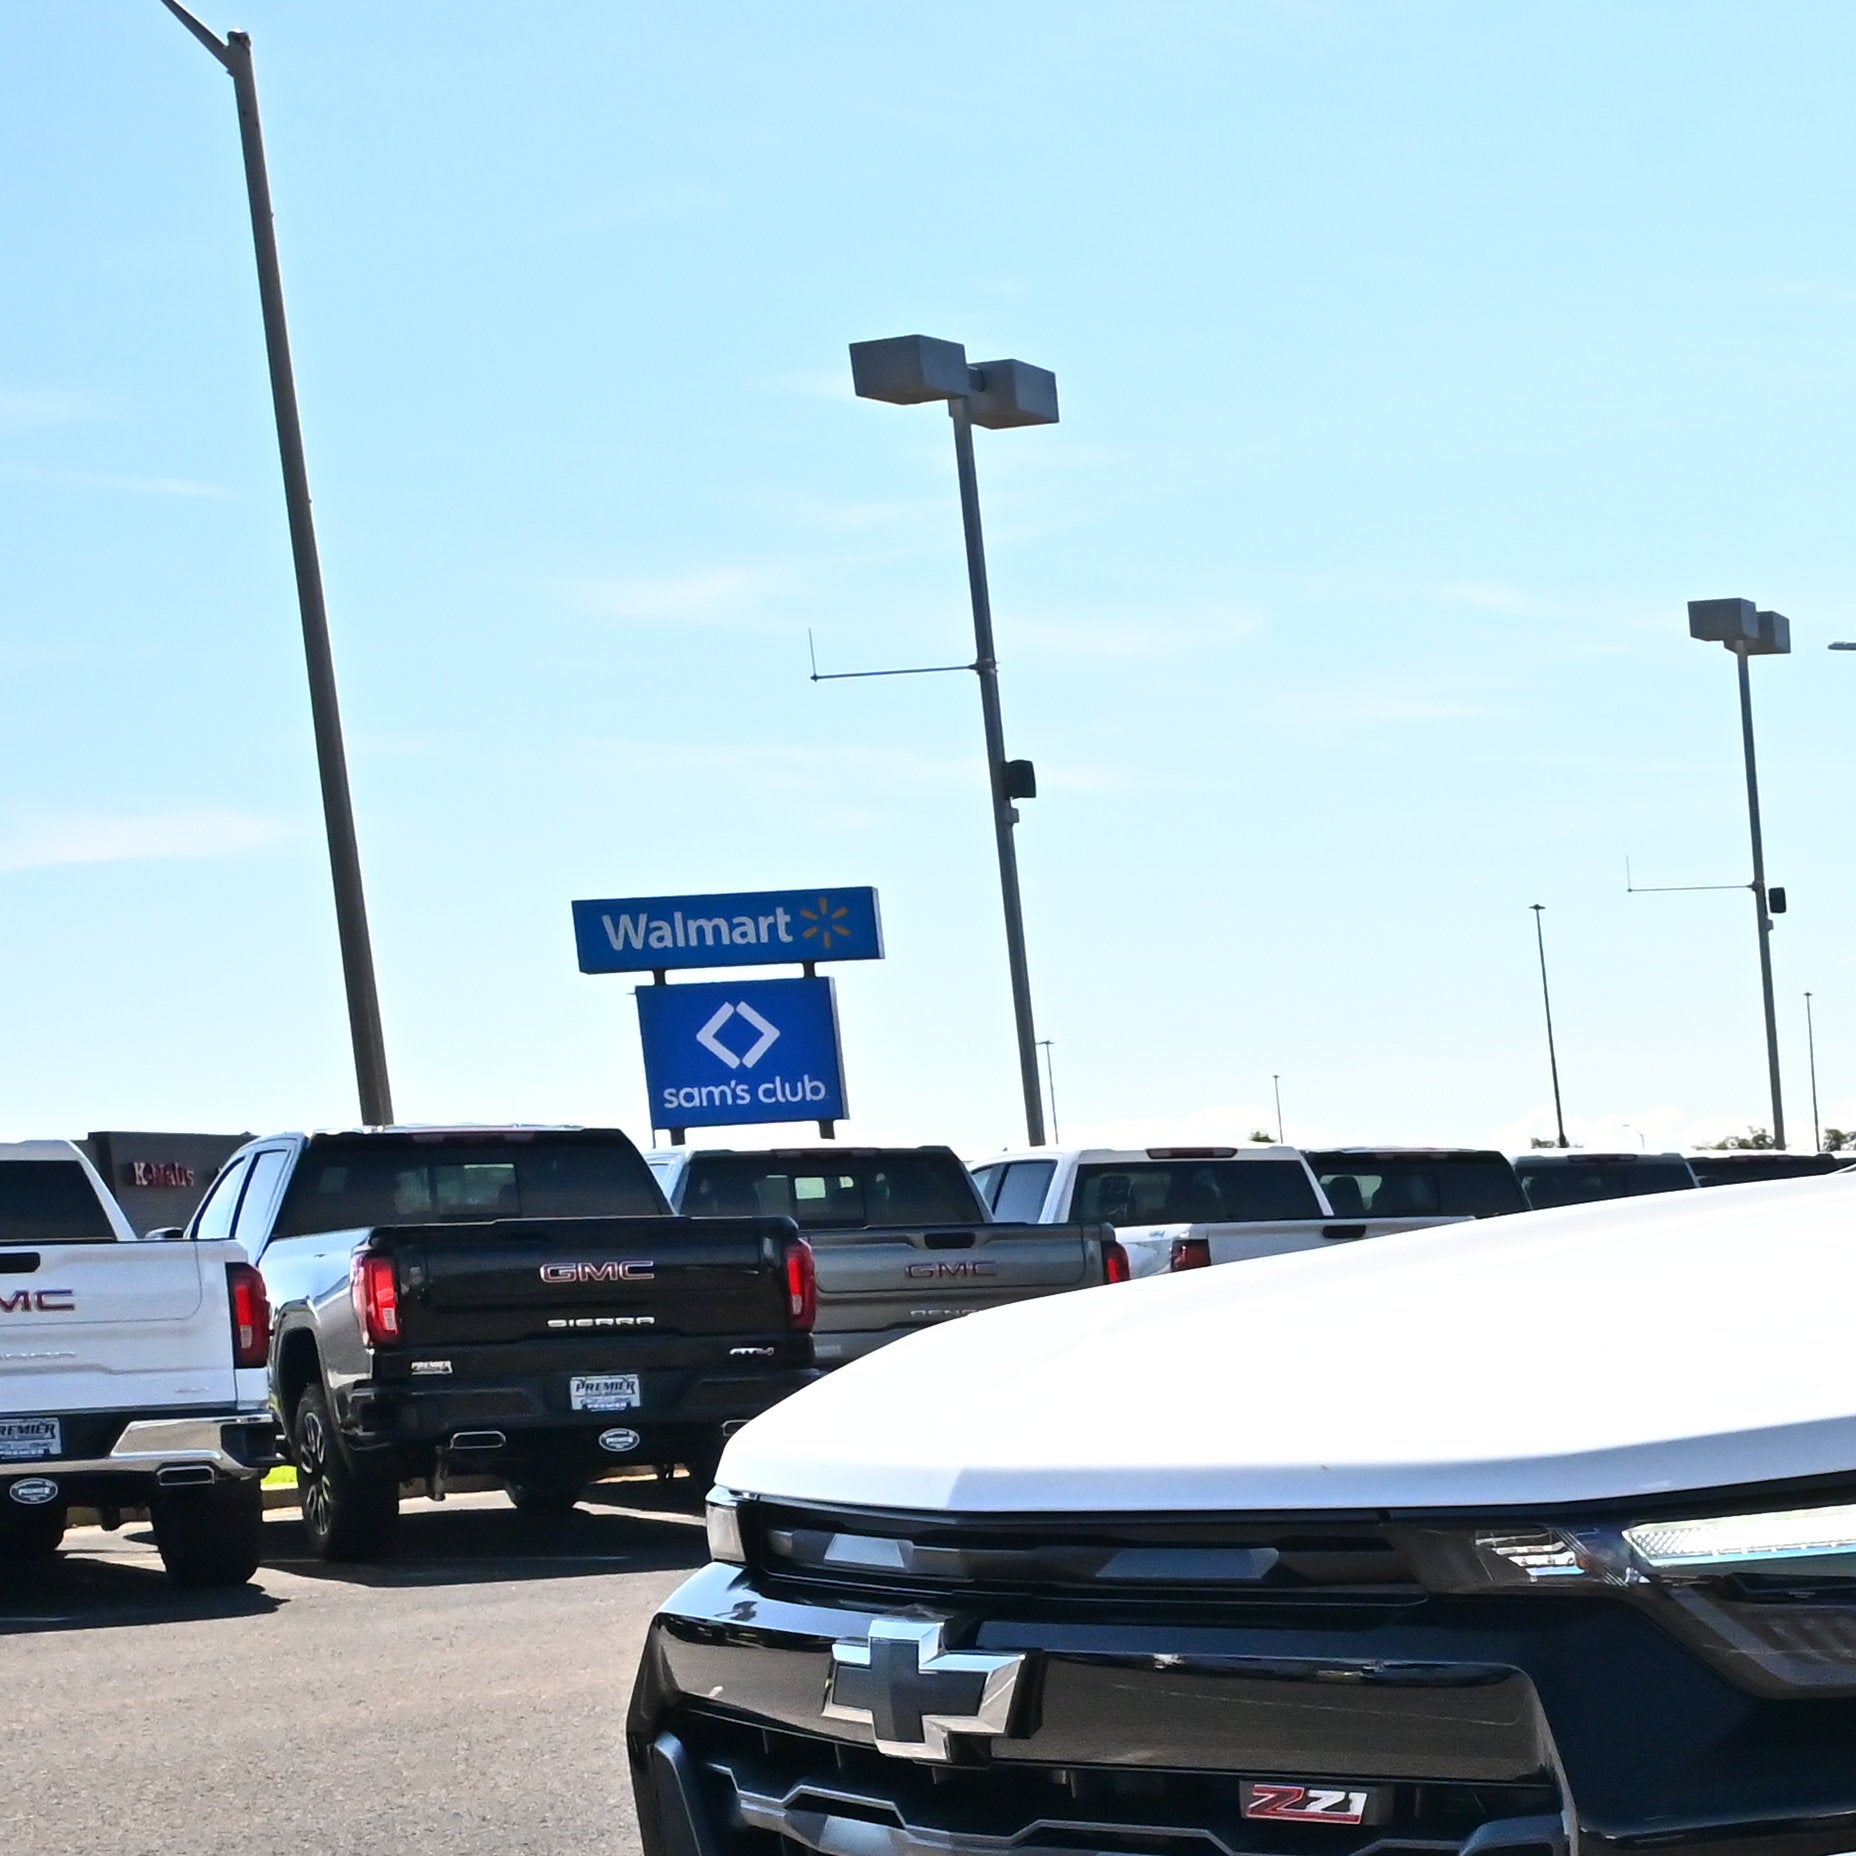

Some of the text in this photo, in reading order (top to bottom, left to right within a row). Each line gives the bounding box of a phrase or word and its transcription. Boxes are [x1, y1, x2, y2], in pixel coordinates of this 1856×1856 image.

[601, 906, 794, 951] Walmart
[663, 1074, 826, 1109] sam's club
[540, 1260, 655, 1283] GMC
[905, 1261, 999, 1279] GMC
[0, 1289, 75, 1312] MC
[575, 1381, 636, 1395] PREMIER
[1246, 1783, 1369, 1825] Z71
